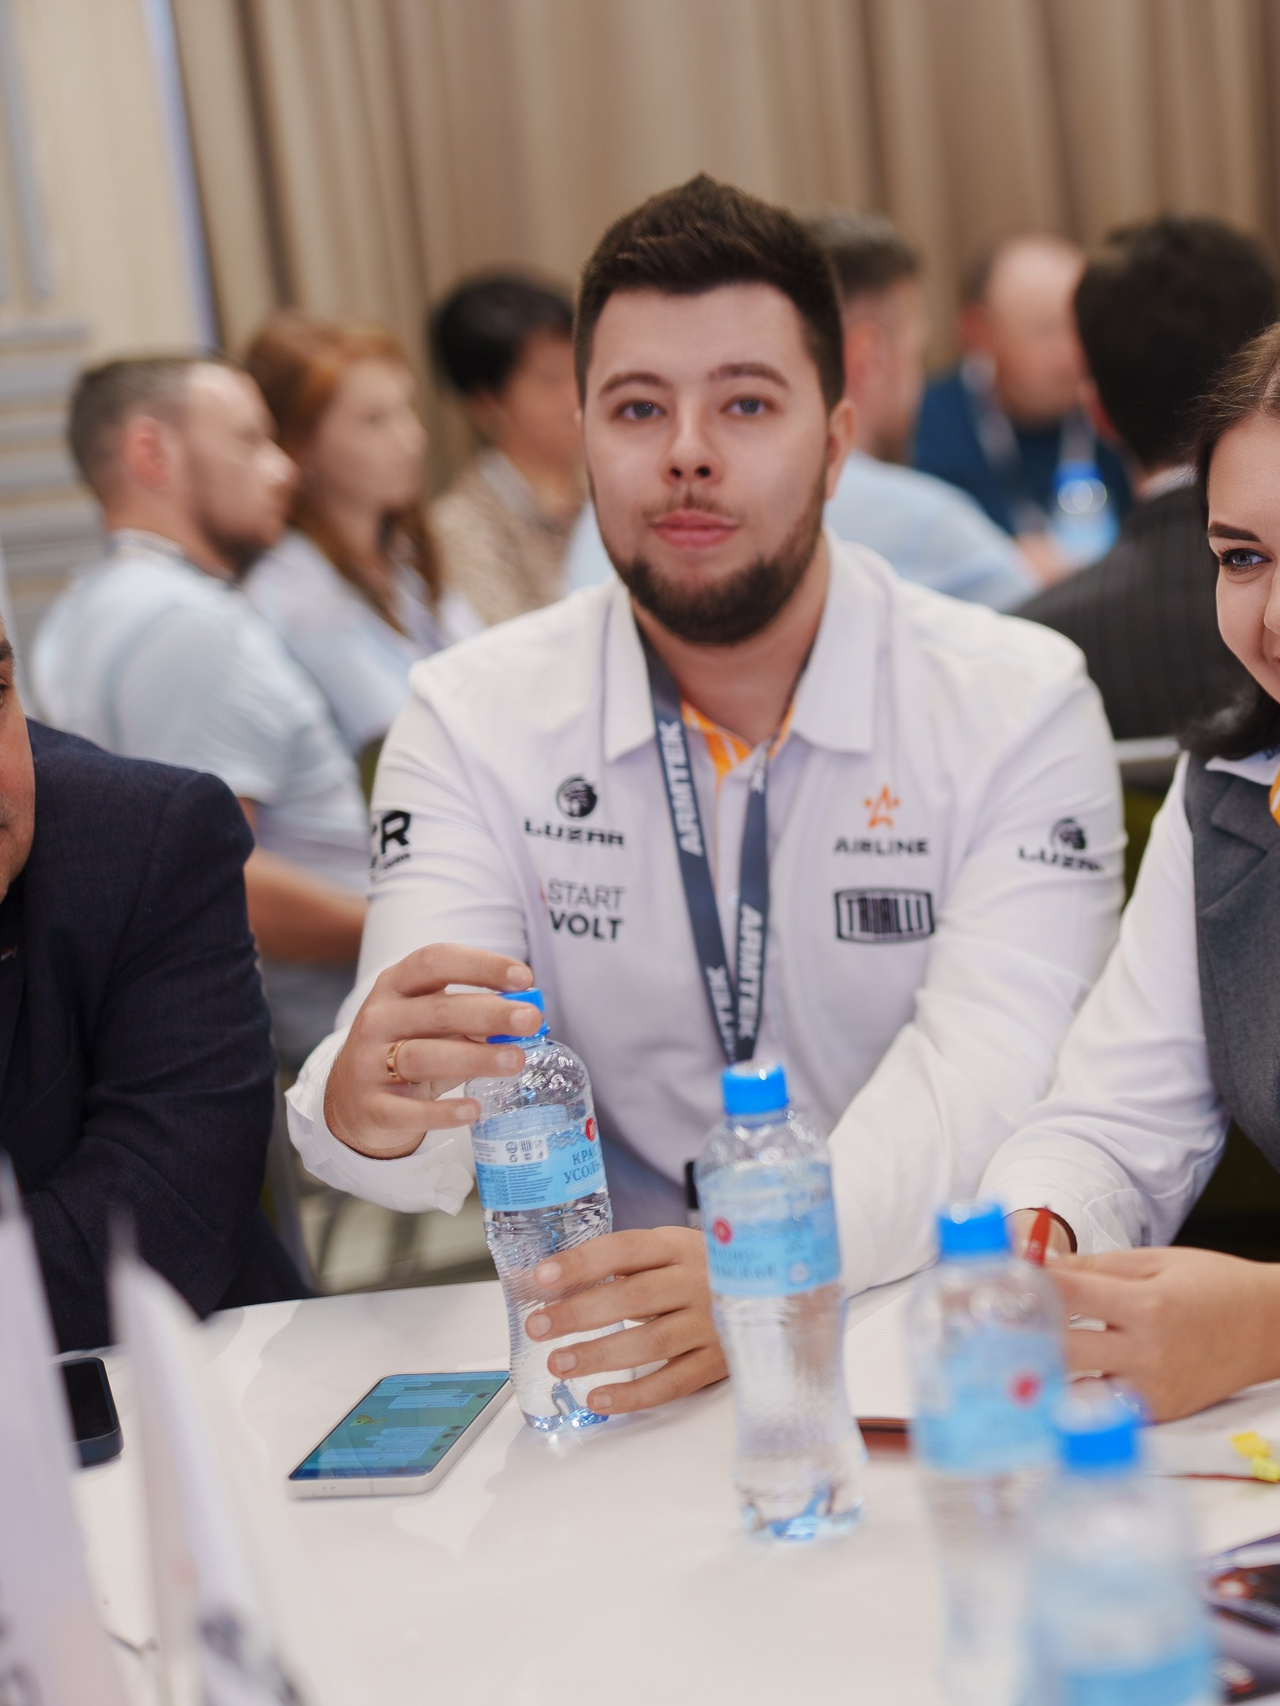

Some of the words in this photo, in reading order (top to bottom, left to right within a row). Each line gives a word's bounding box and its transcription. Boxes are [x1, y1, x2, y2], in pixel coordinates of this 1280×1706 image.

[658, 719, 704, 858] ARMTEK
[524, 819, 626, 846] LUZAR
[834, 837, 930, 856] AIRLINE
[548, 879, 626, 911] START
[549, 910, 623, 941] VOLT
[737, 902, 763, 1039] ARMTEK
